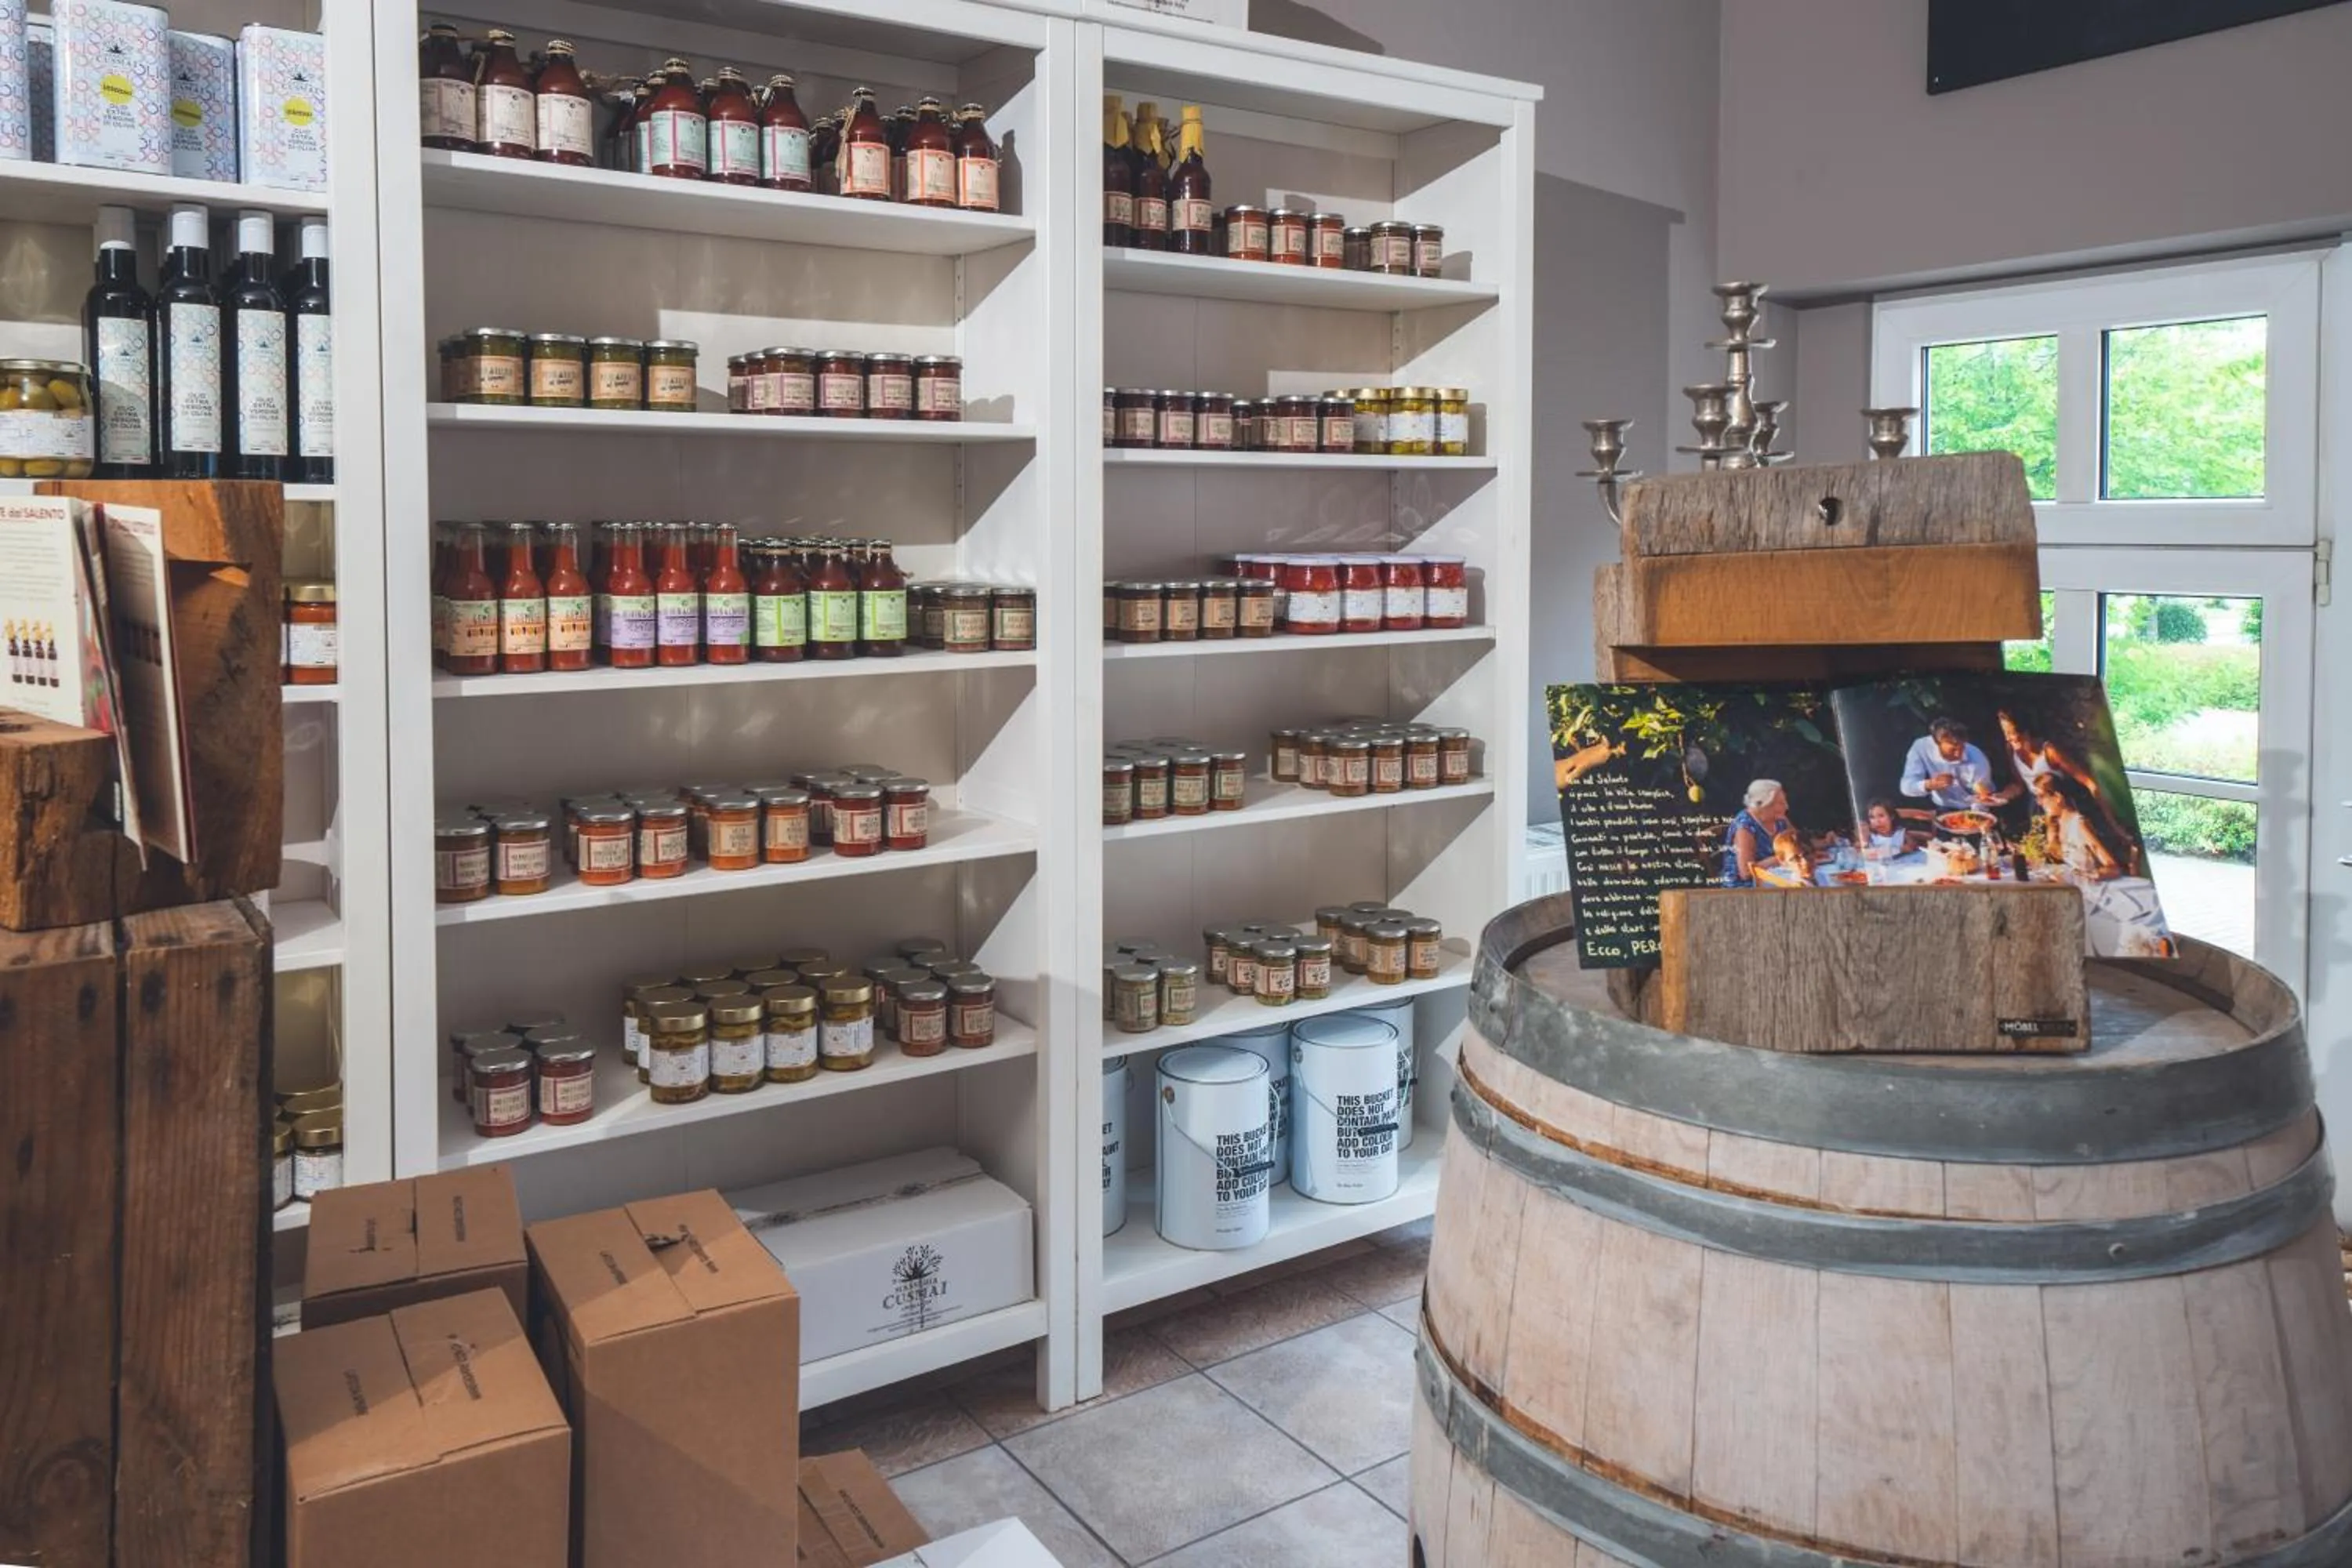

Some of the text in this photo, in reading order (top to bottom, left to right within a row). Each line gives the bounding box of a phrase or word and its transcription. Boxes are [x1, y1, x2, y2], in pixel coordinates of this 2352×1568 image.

[1337, 1087, 1394, 1106] THIS BUCKET
[1337, 1102, 1385, 1116] DOES NOT
[1337, 1113, 1381, 1127] CONTAIN
[1216, 1134, 1241, 1146] THIS
[1216, 1144, 1244, 1156] DOES
[1247, 1138, 1263, 1151] NOT
[1337, 1131, 1393, 1149] ADD COLOUR
[1216, 1152, 1258, 1169] CONTAIN
[1337, 1148, 1351, 1159] TO
[1352, 1145, 1379, 1159] YOUR
[1216, 1179, 1240, 1191] ADD
[1216, 1190, 1231, 1202] TO
[1233, 1185, 1257, 1200] YOUR
[882, 1280, 947, 1310] CUSMAI
